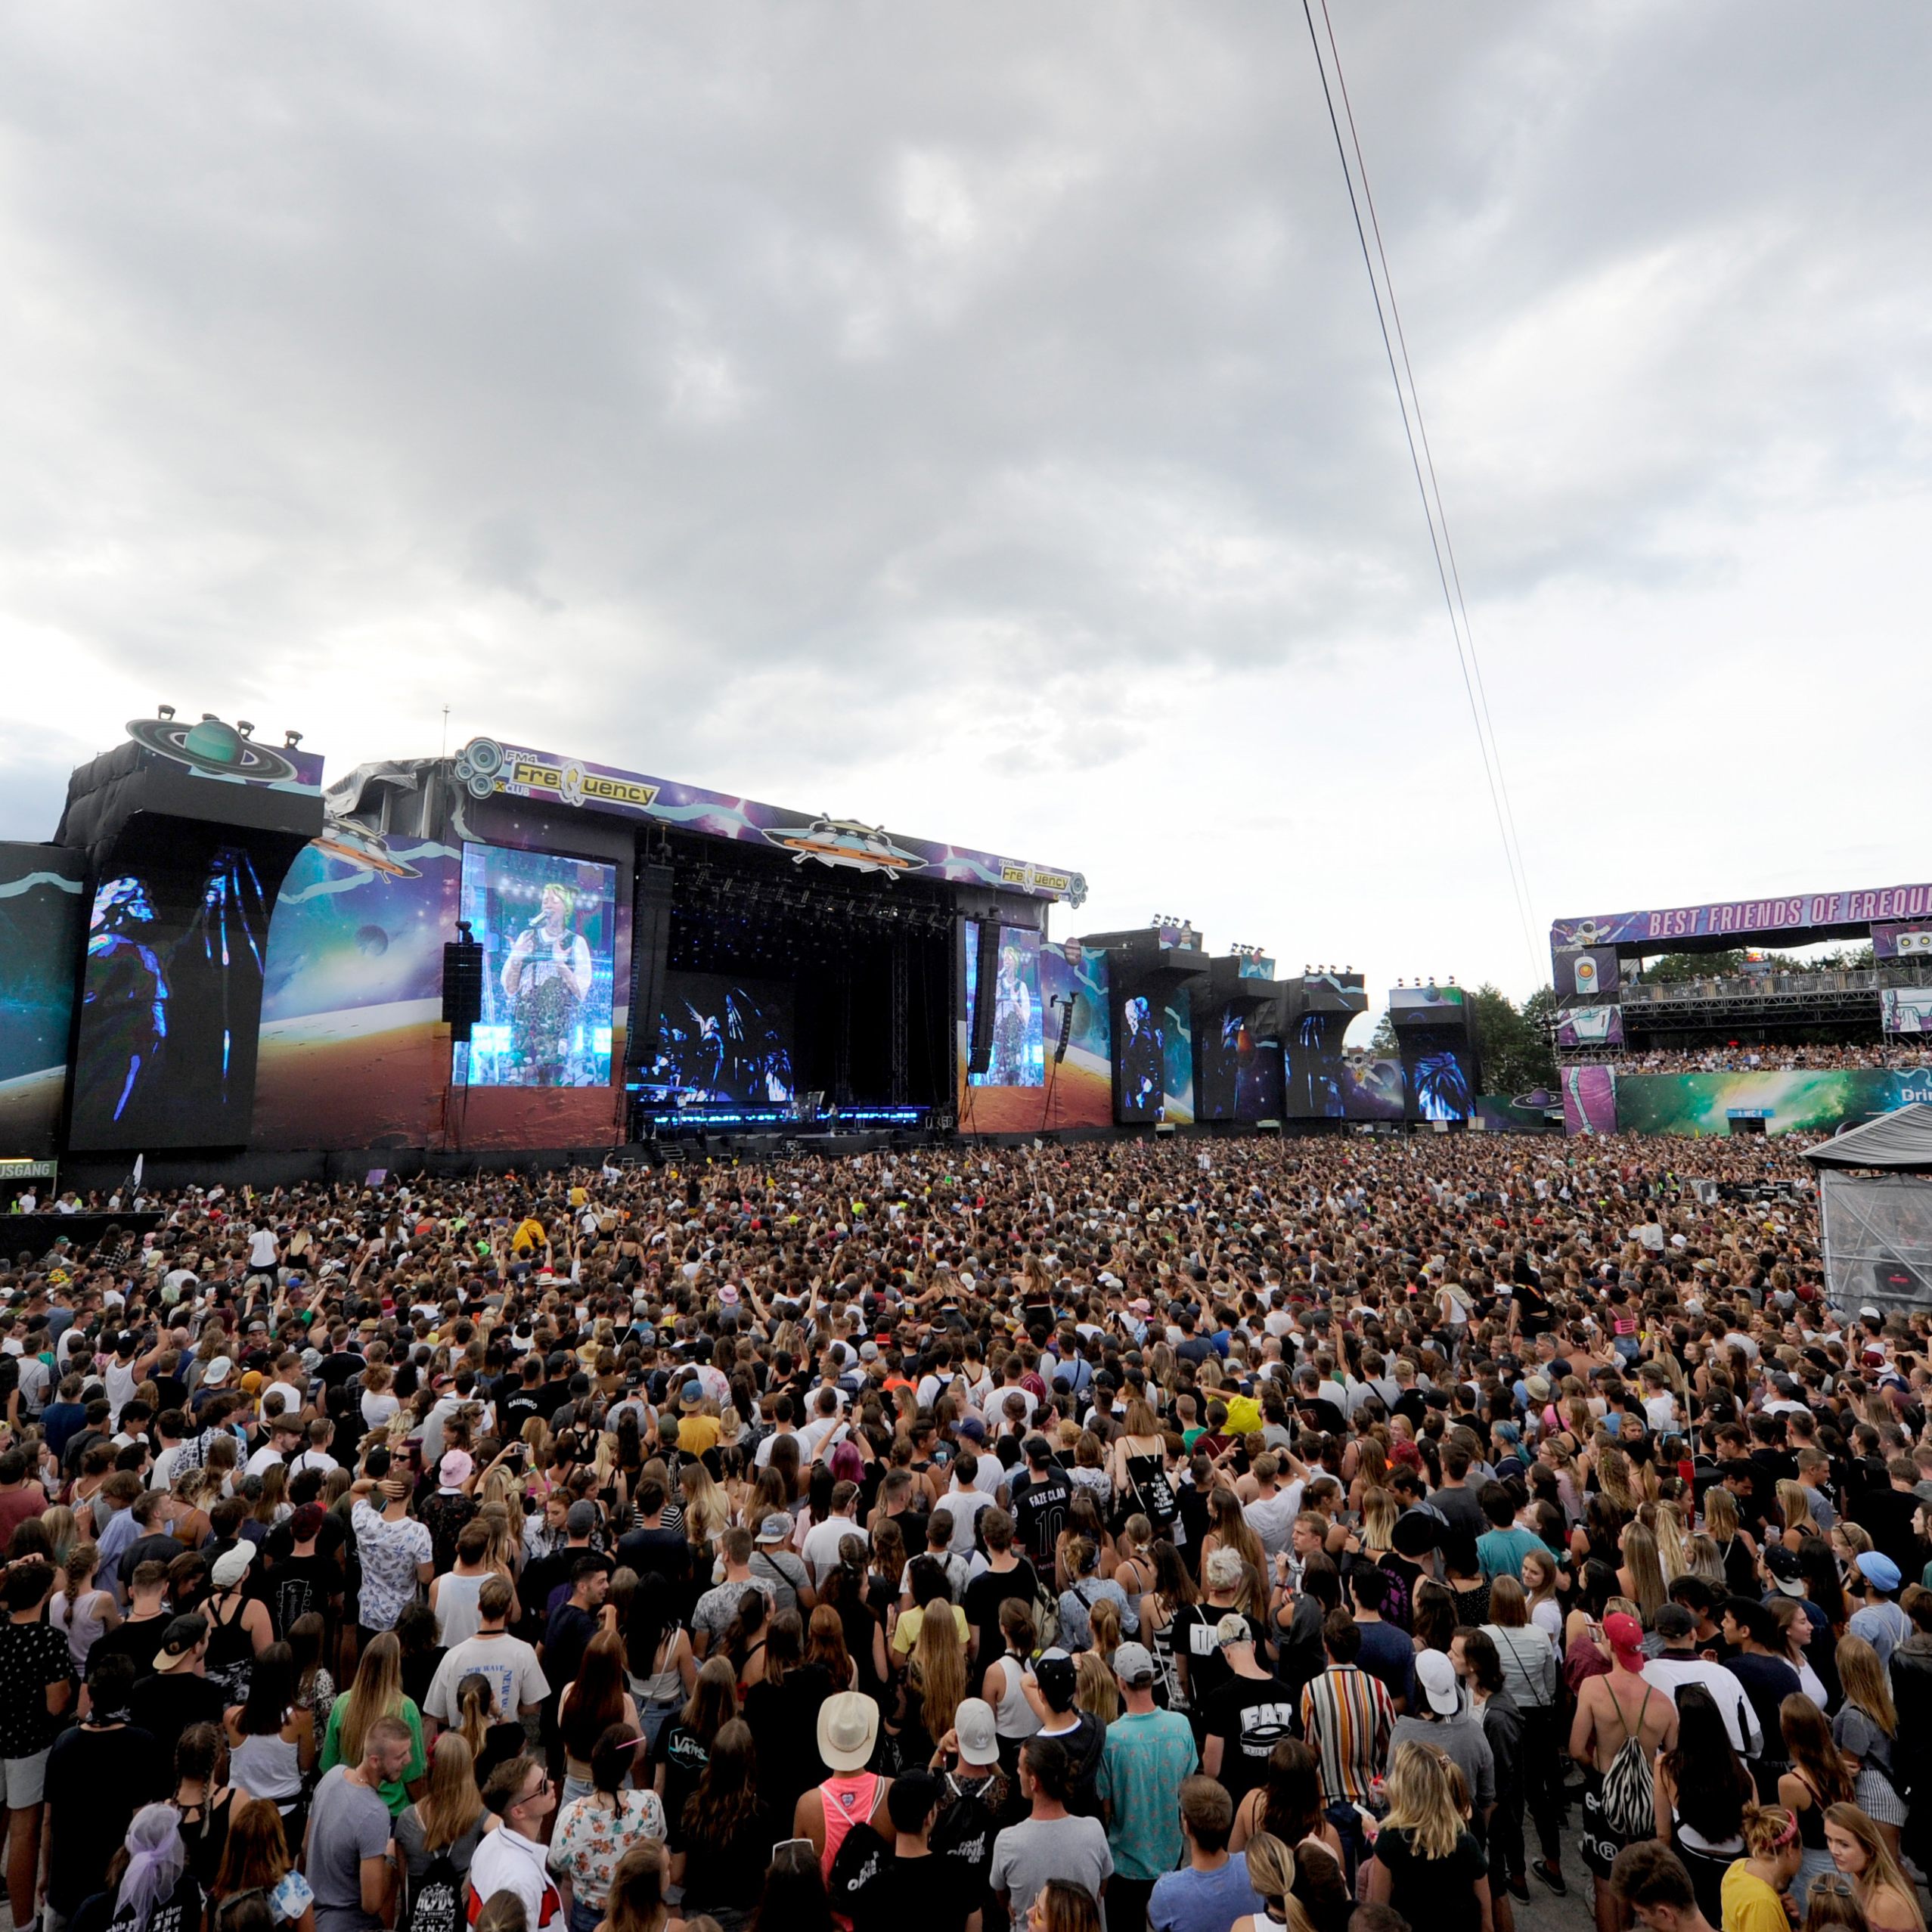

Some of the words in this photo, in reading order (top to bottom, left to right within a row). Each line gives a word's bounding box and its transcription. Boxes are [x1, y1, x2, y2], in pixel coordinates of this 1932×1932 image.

[506, 750, 538, 764] FM4
[506, 784, 529, 796] CLUB
[1649, 910, 1701, 938] BEST
[1709, 898, 1802, 932] FRIENDS
[1811, 895, 1840, 923] OF
[1240, 1703, 1292, 1734] EAT
